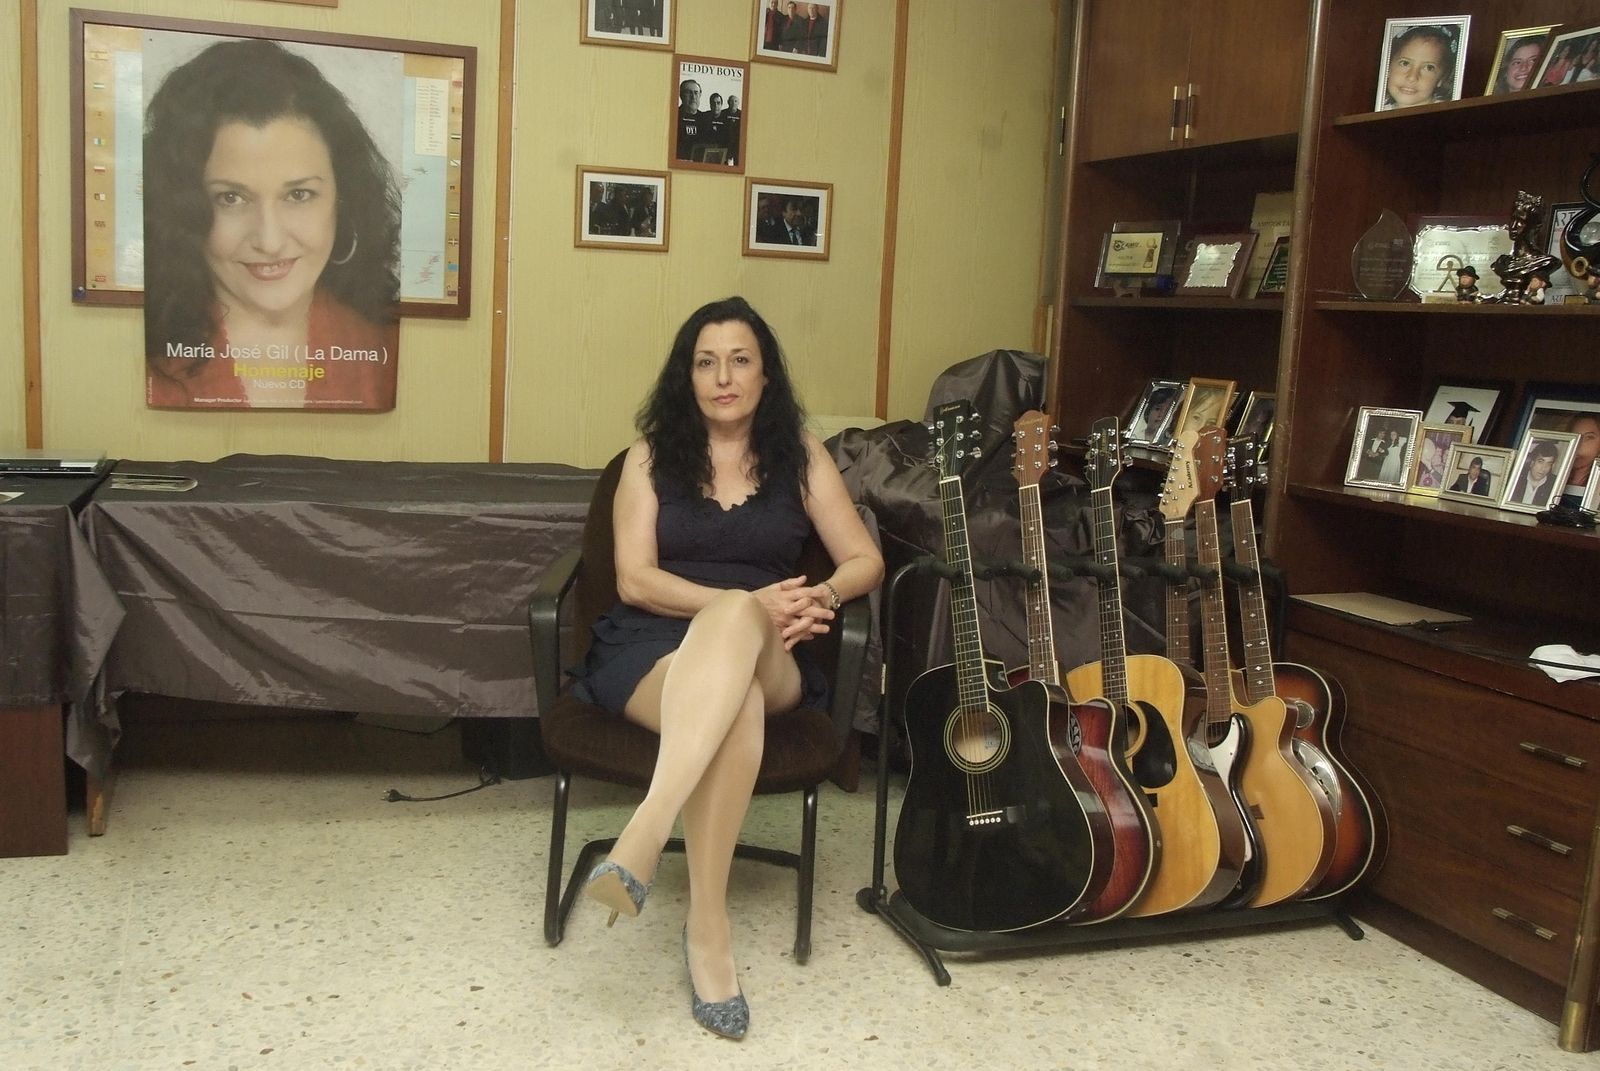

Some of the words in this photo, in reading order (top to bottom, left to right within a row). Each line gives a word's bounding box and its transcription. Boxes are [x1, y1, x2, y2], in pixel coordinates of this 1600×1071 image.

[682, 63, 715, 75] TEDDY
[716, 67, 742, 78] BOYS
[166, 342, 215, 358] María
[220, 343, 261, 359] José
[266, 344, 289, 360] Gil
[305, 345, 325, 360] La
[330, 346, 379, 361] Dama
[233, 362, 325, 381] Homenaje
[253, 379, 287, 389] Nuevo
[289, 379, 306, 389] CD
